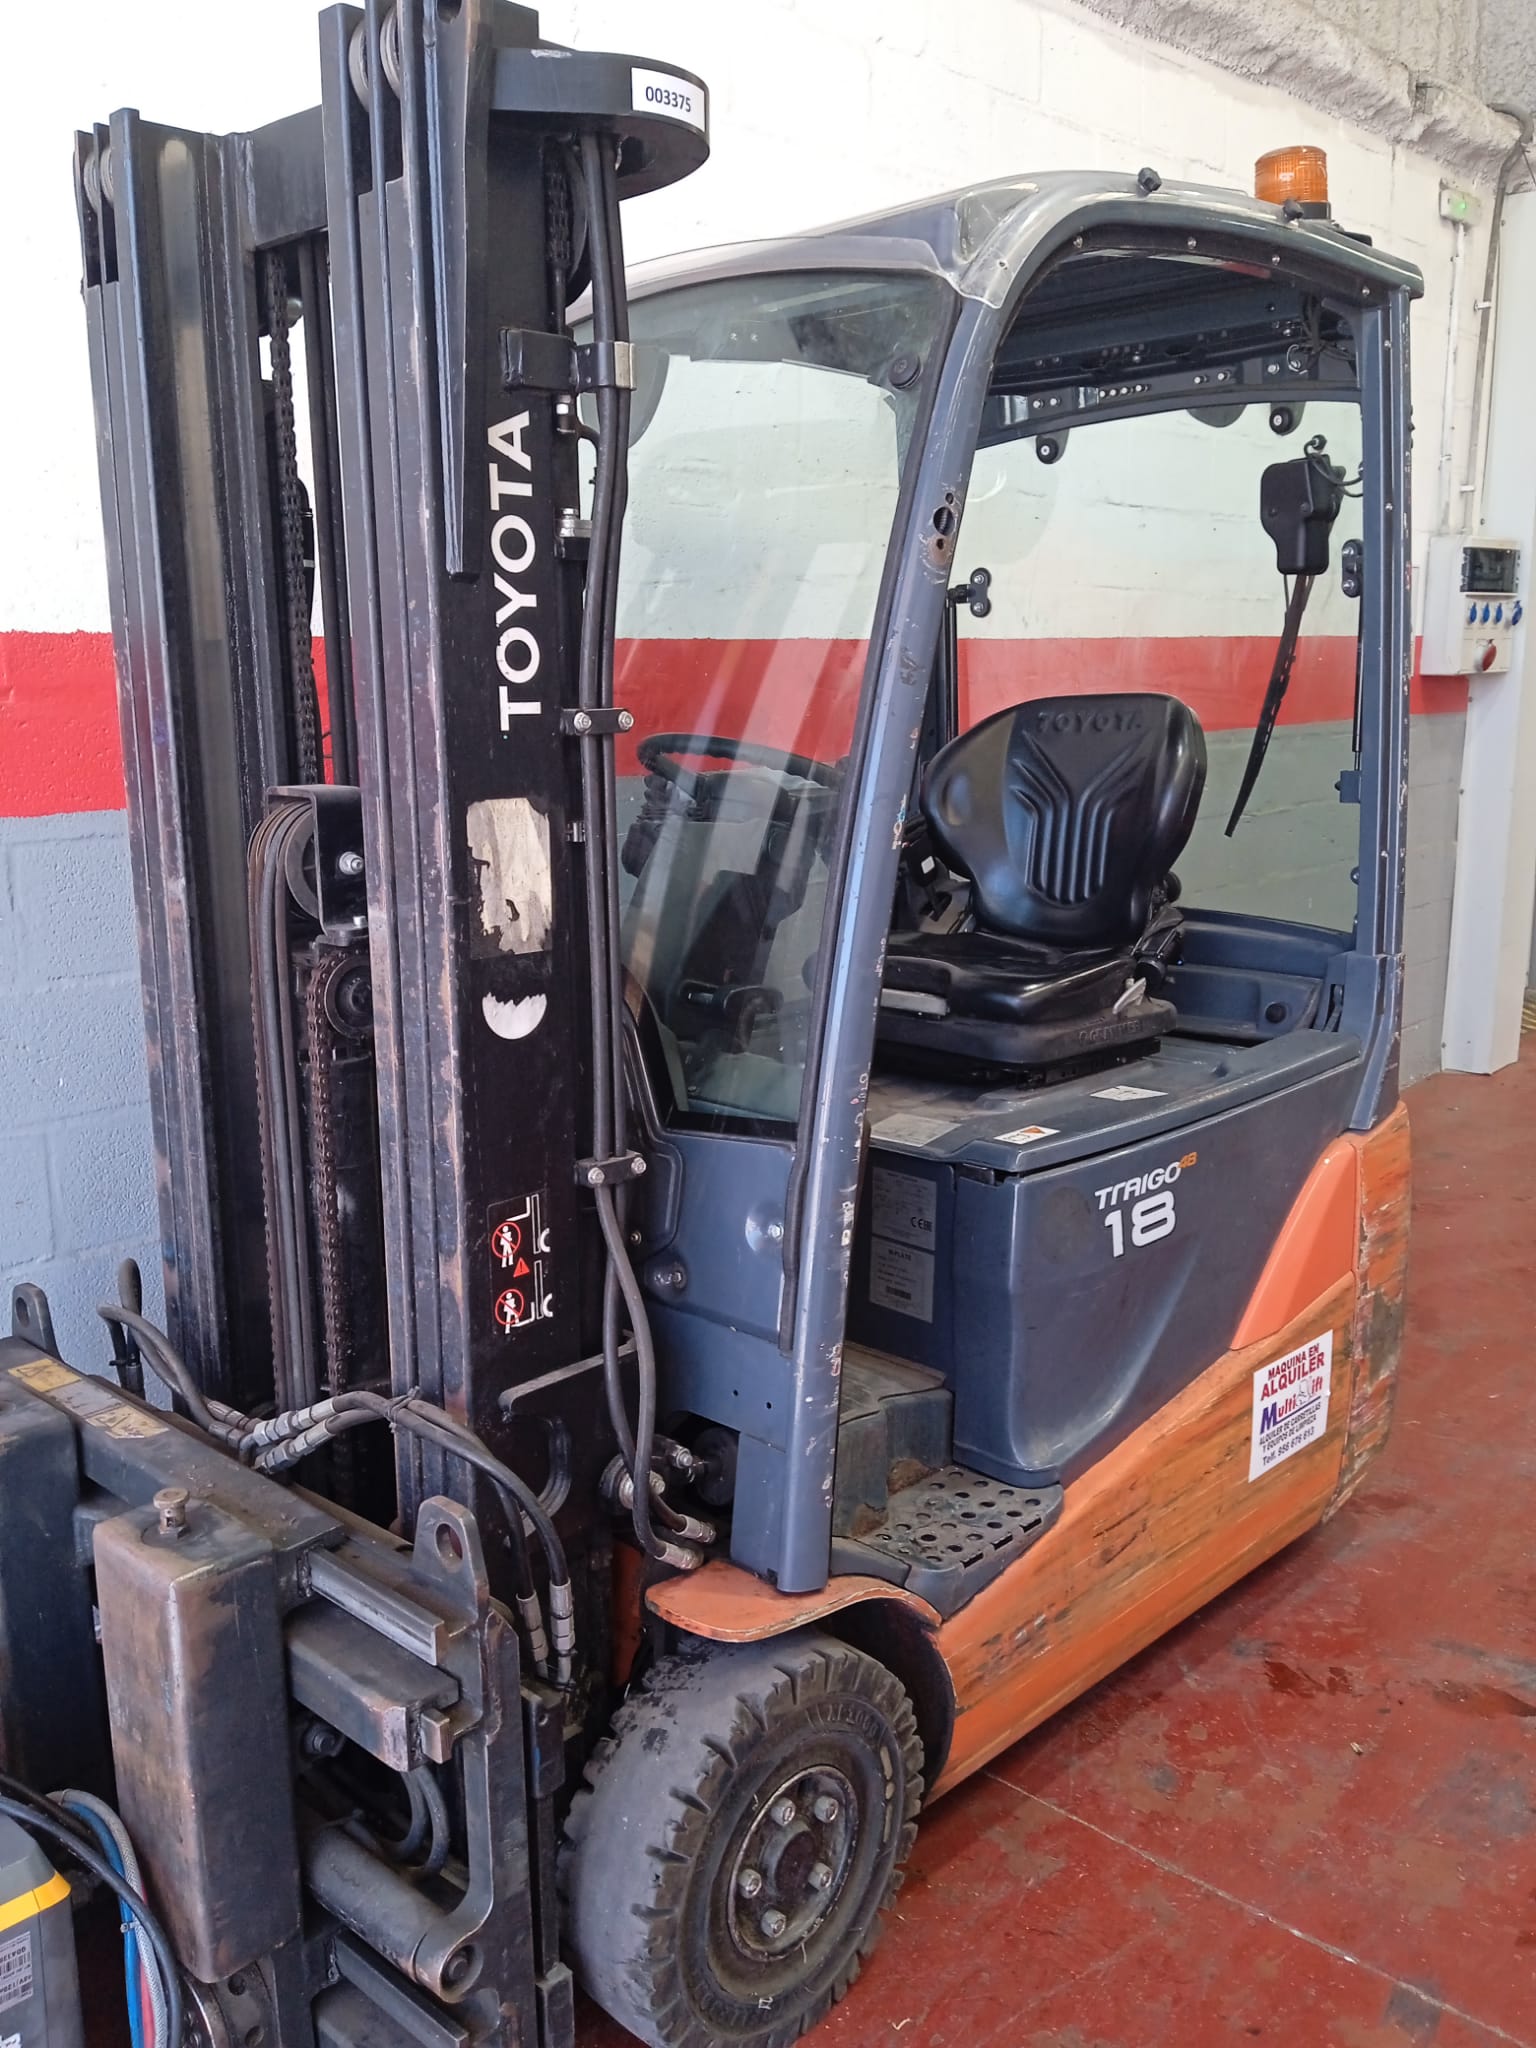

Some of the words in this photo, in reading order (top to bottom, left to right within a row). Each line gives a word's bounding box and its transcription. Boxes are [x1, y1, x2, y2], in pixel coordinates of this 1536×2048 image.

[645, 86, 691, 112] 003375
[487, 410, 541, 731] TOYOTA
[1104, 1190, 1176, 1258] 18
[1260, 1351, 1325, 1401] ALQUILER
[1268, 1350, 1307, 1380] MAQUINA
[1309, 1343, 1320, 1358] EN
